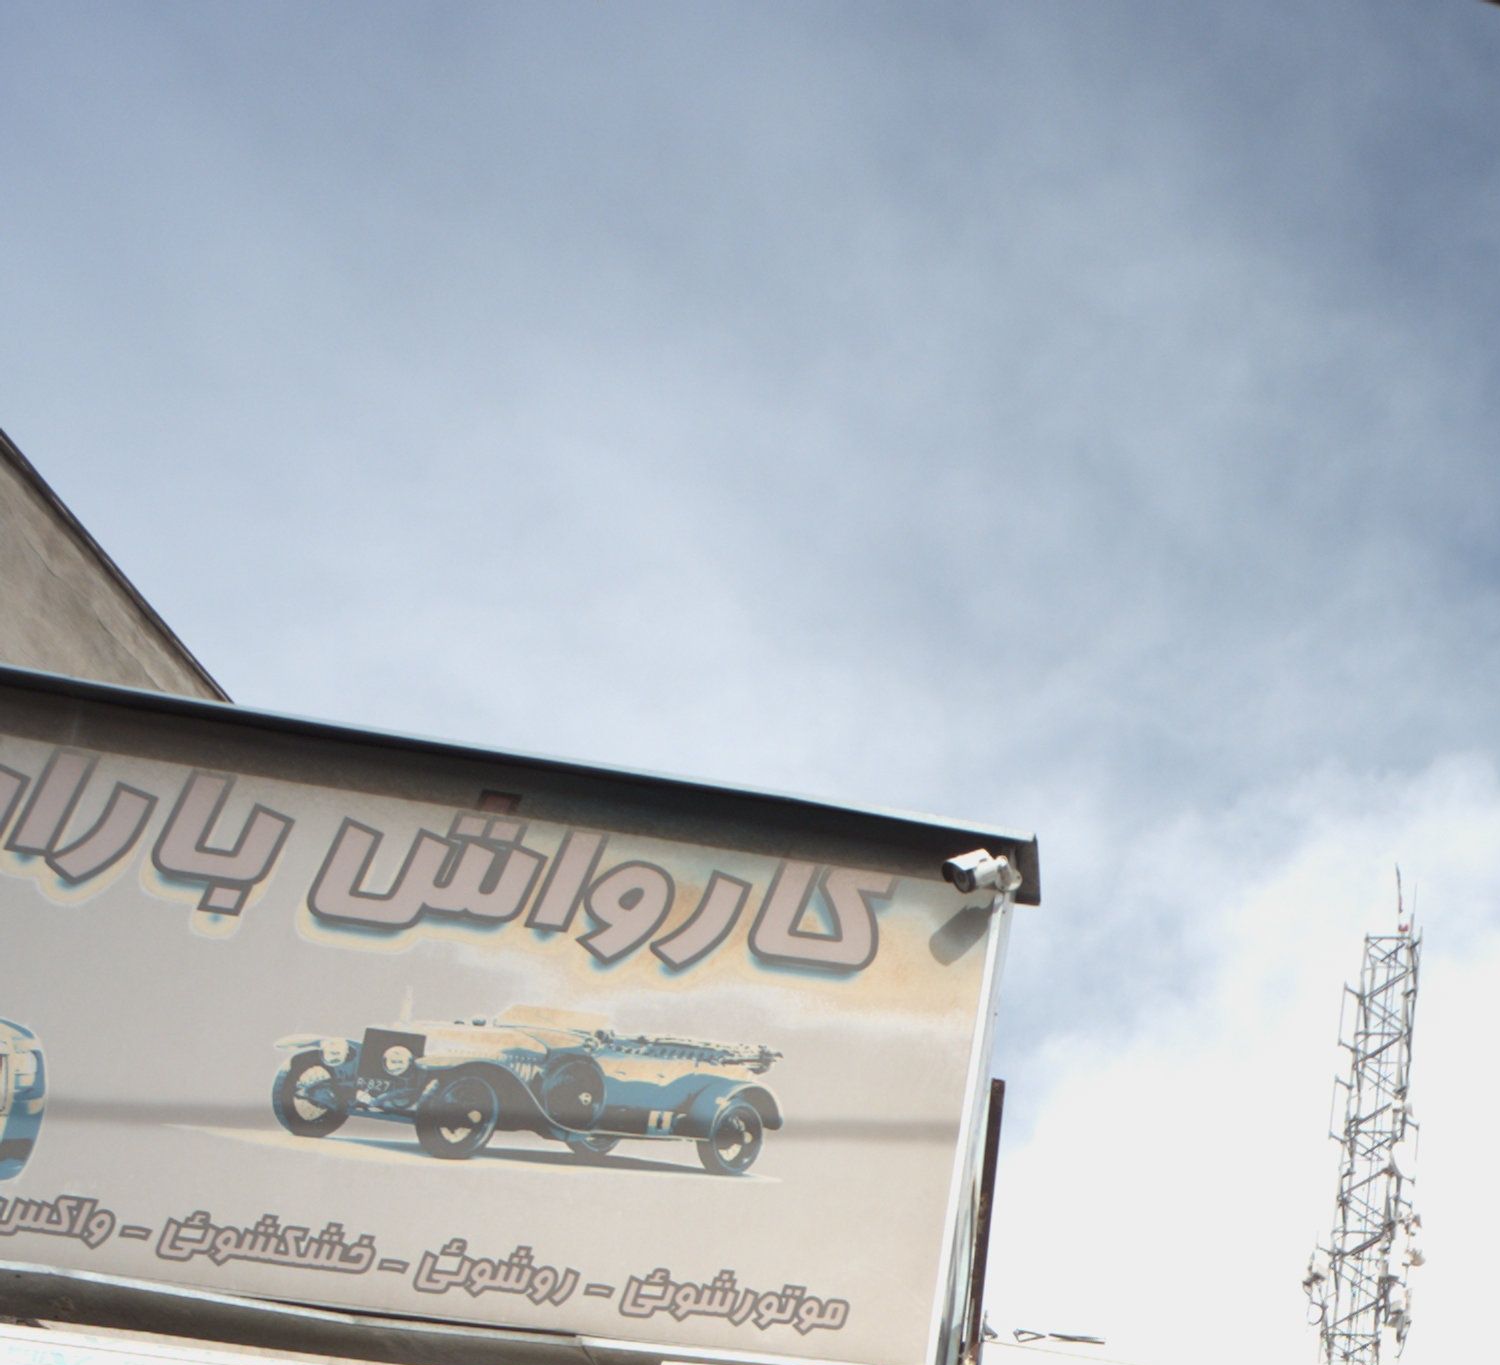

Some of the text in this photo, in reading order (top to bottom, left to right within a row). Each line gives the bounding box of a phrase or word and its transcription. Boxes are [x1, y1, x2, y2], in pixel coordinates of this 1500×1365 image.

[0, 747, 898, 972] کارواش بارا
[155, 1210, 376, 1275] خشکشوئی
[412, 1237, 581, 1306] روشوئی
[618, 1267, 850, 1335] موتورشوئی
